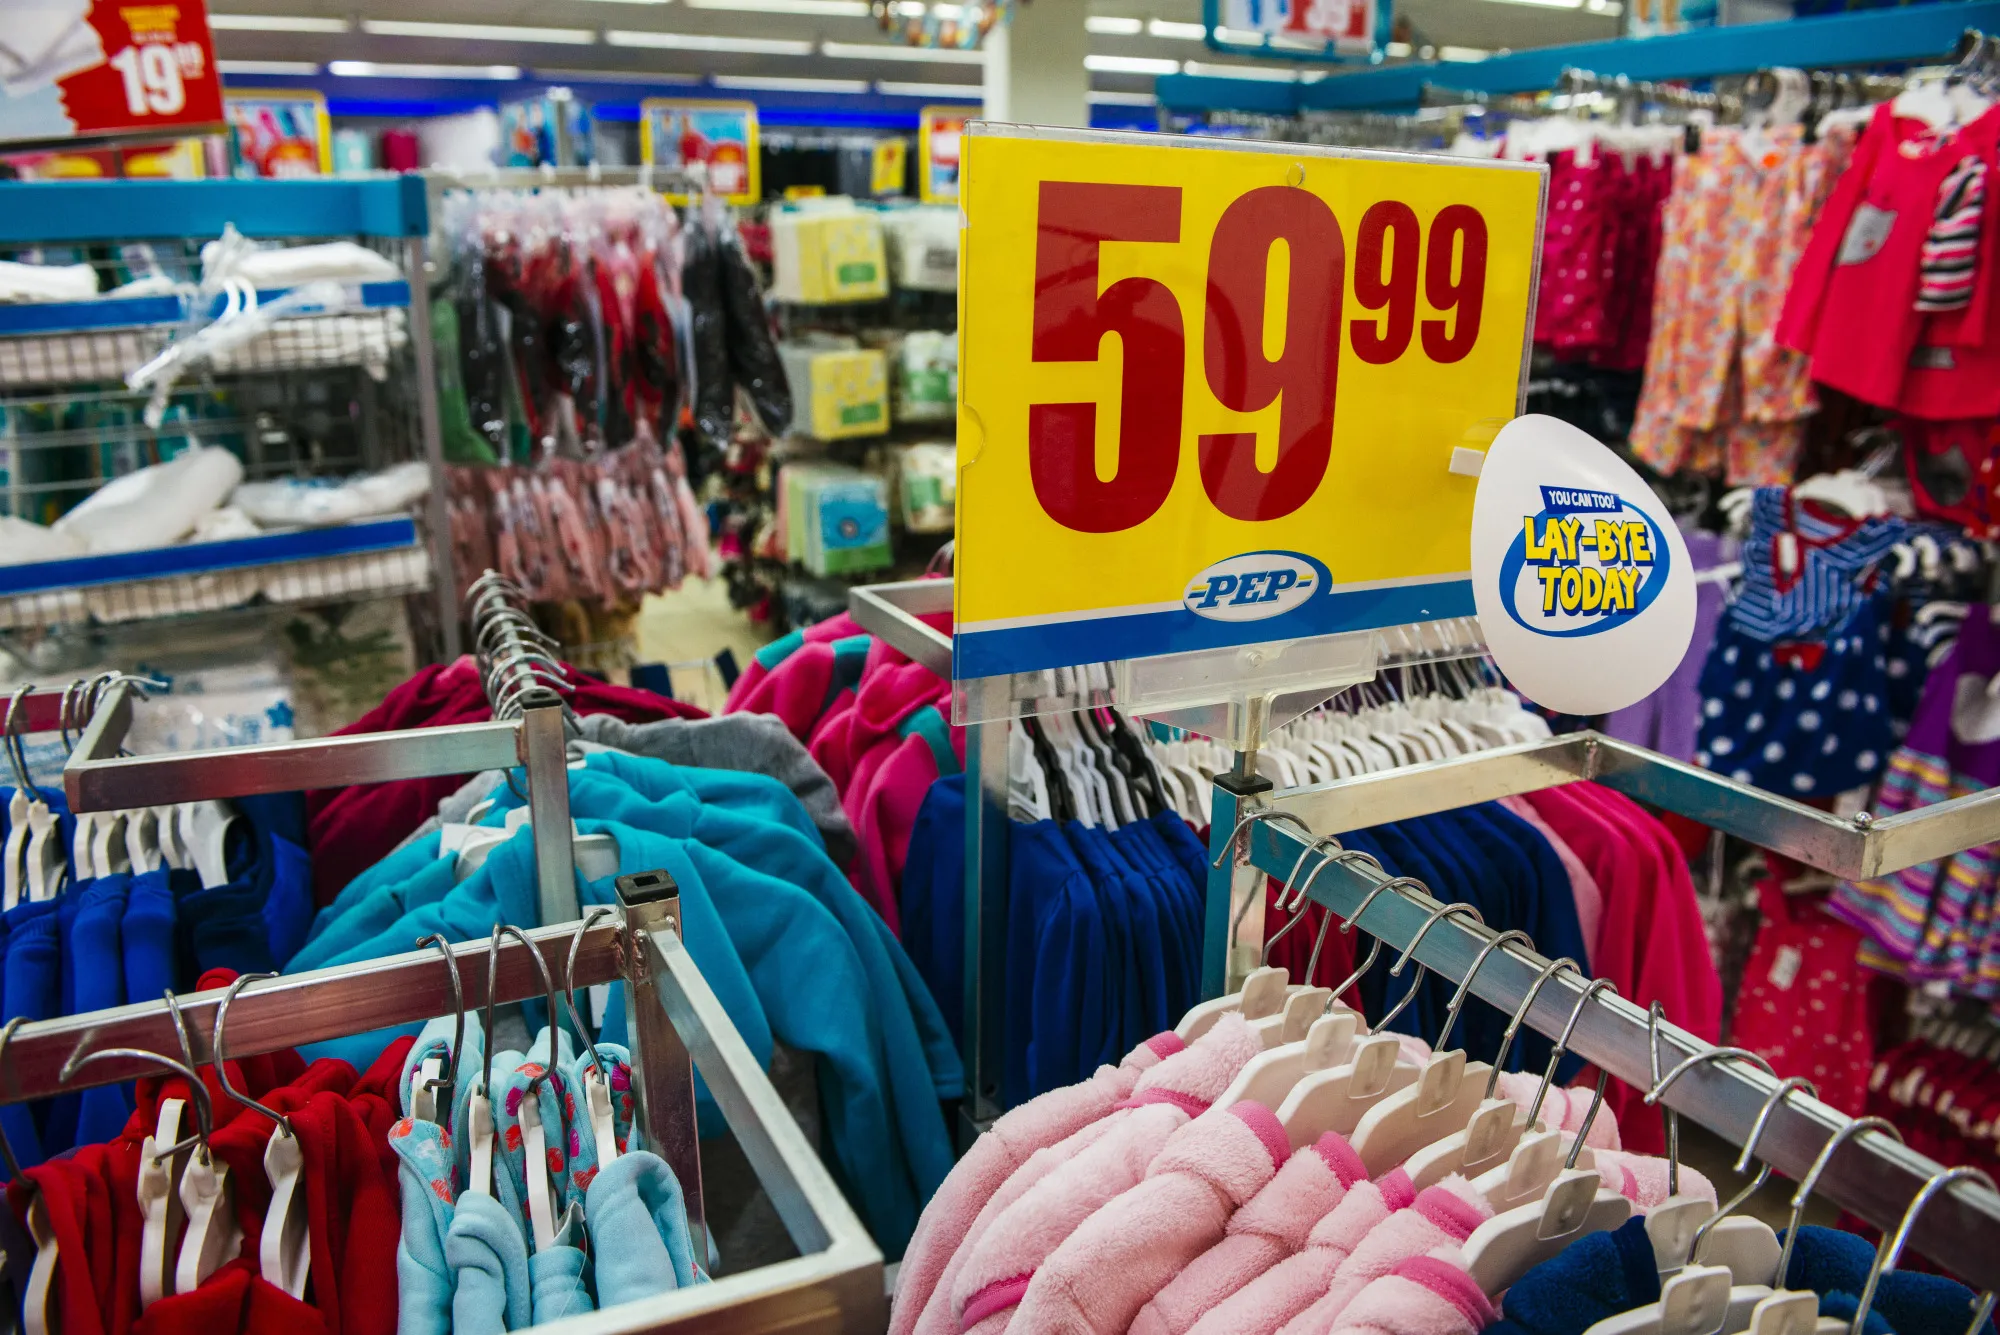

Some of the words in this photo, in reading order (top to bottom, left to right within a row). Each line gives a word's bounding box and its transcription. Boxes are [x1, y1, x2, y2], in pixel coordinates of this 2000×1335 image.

[110, 44, 186, 116] 19
[1028, 180, 1346, 534] 59
[1349, 200, 1489, 366] 99
[1548, 490, 1570, 505] YOU
[1571, 491, 1593, 507] CAN
[1592, 494, 1616, 509] TOO!
[1523, 516, 1655, 567] LAY-BYE
[1195, 568, 1298, 610] PEP
[1537, 565, 1643, 617] TODAY
